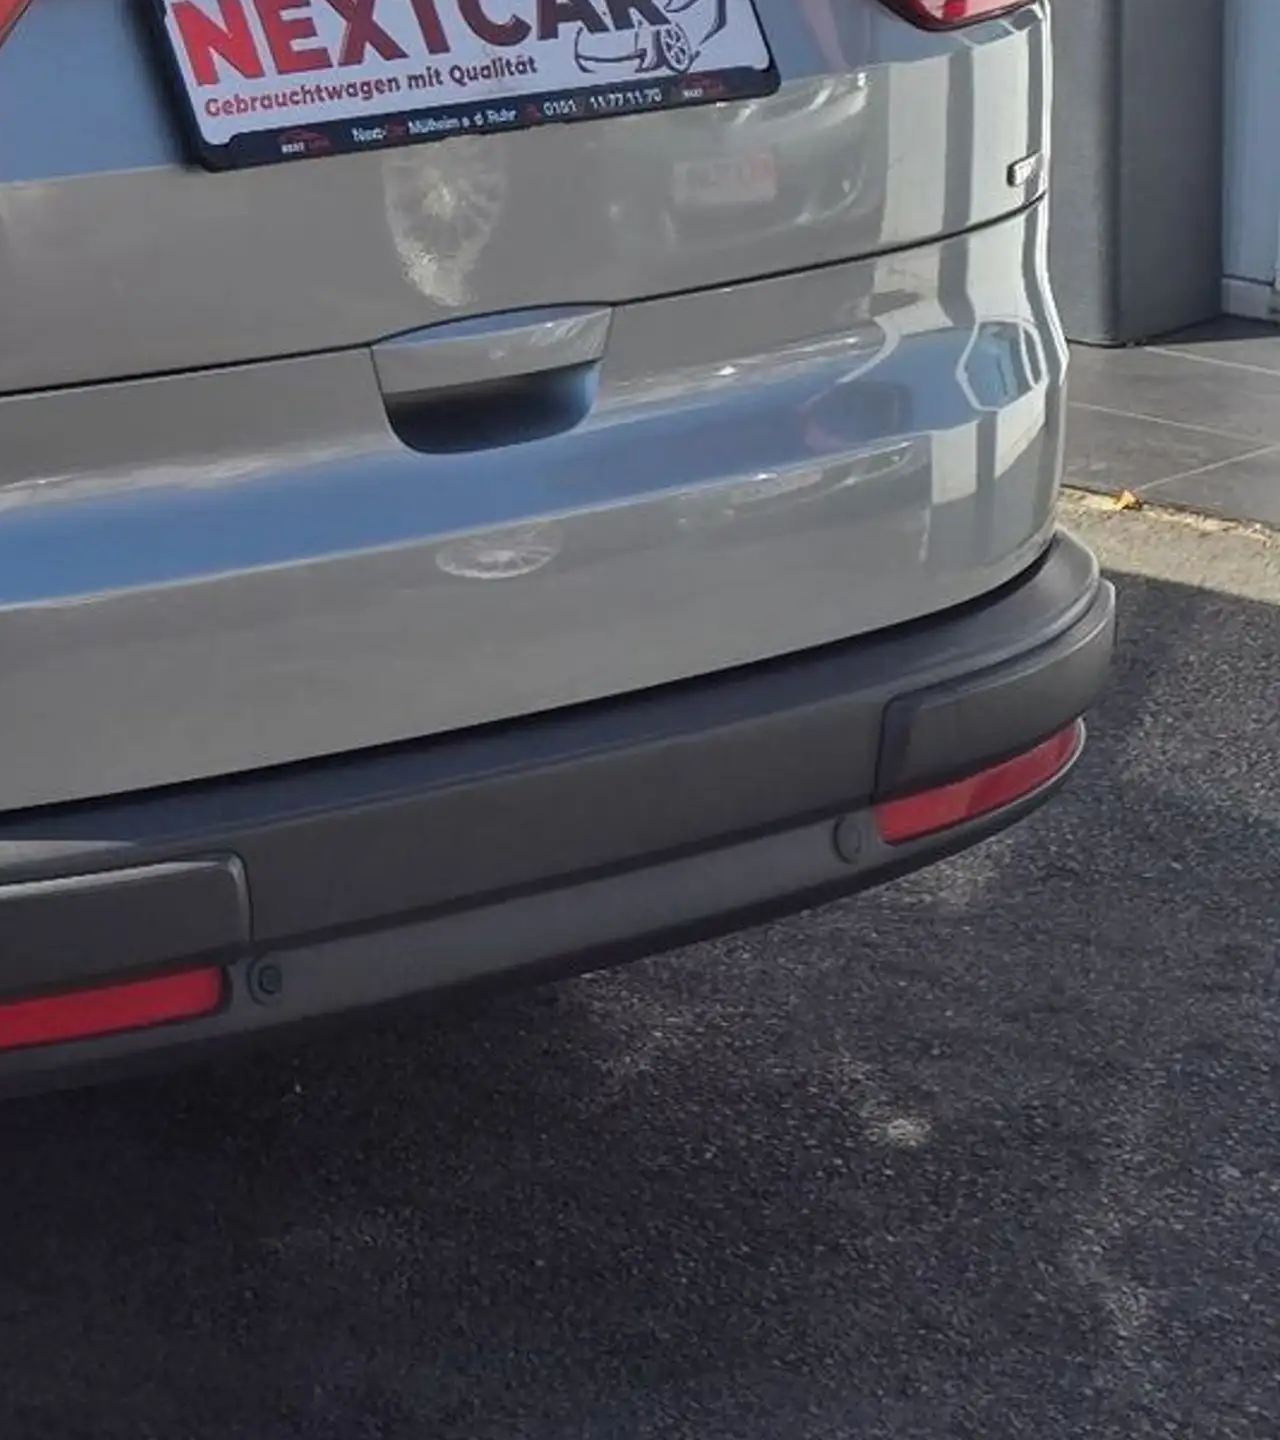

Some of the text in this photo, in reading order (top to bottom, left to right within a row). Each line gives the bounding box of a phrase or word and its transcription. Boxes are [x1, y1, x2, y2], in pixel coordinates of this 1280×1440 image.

[204, 54, 538, 118] Gebrauchtwagen mit Qualität
